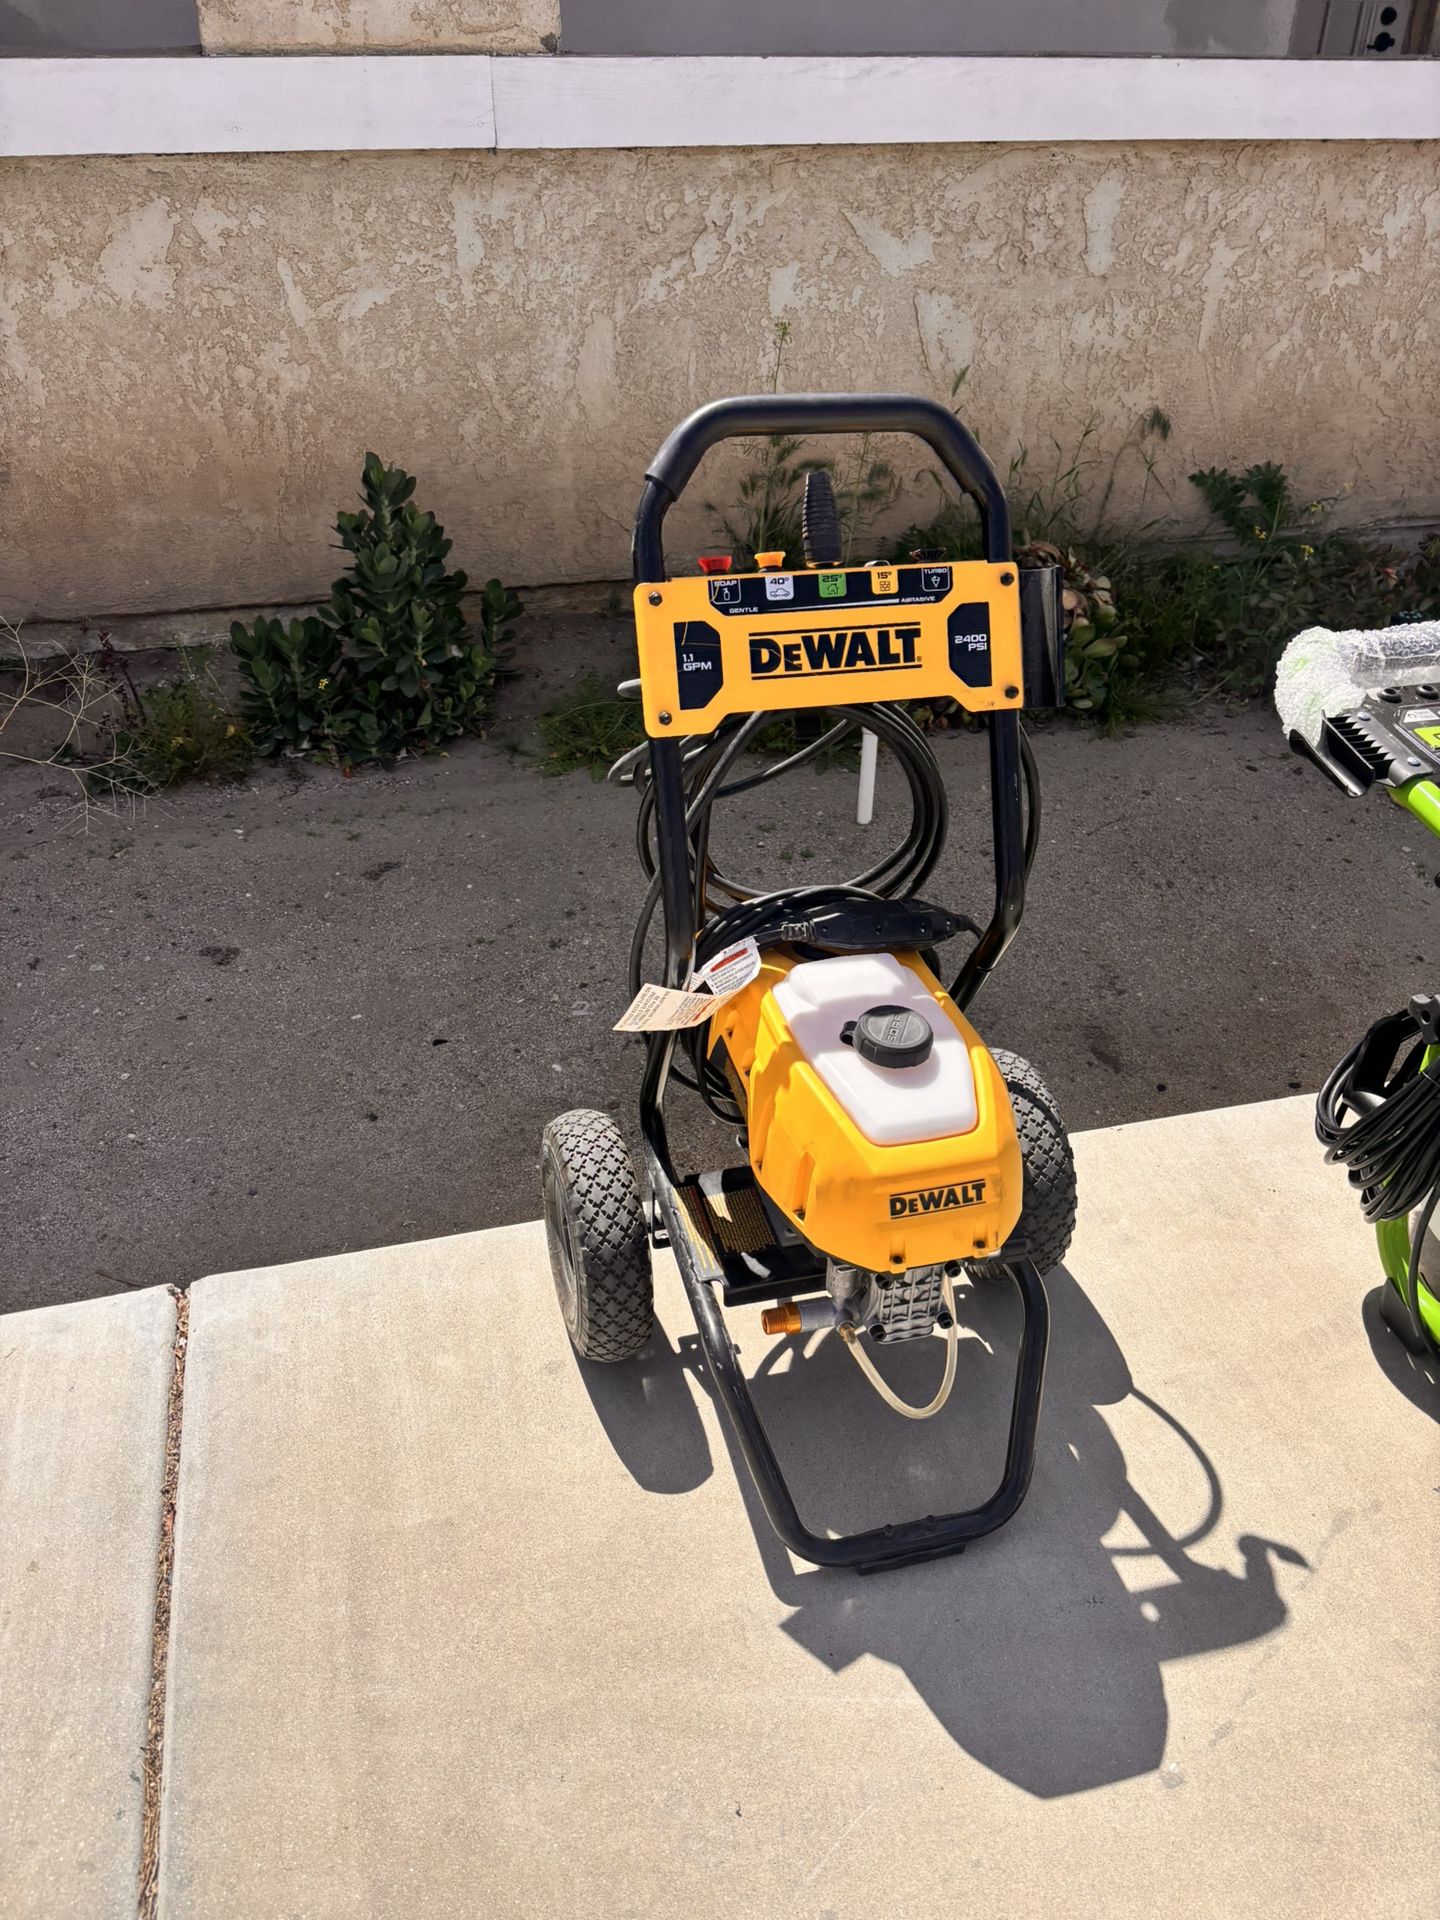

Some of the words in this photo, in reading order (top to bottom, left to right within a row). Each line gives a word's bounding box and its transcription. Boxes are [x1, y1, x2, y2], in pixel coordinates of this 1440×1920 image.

[729, 606, 759, 614] GENTLE
[954, 634, 987, 644] 2400
[968, 642, 987, 651] PSI
[682, 653, 694, 662] 1.1
[683, 661, 712, 671] GPM
